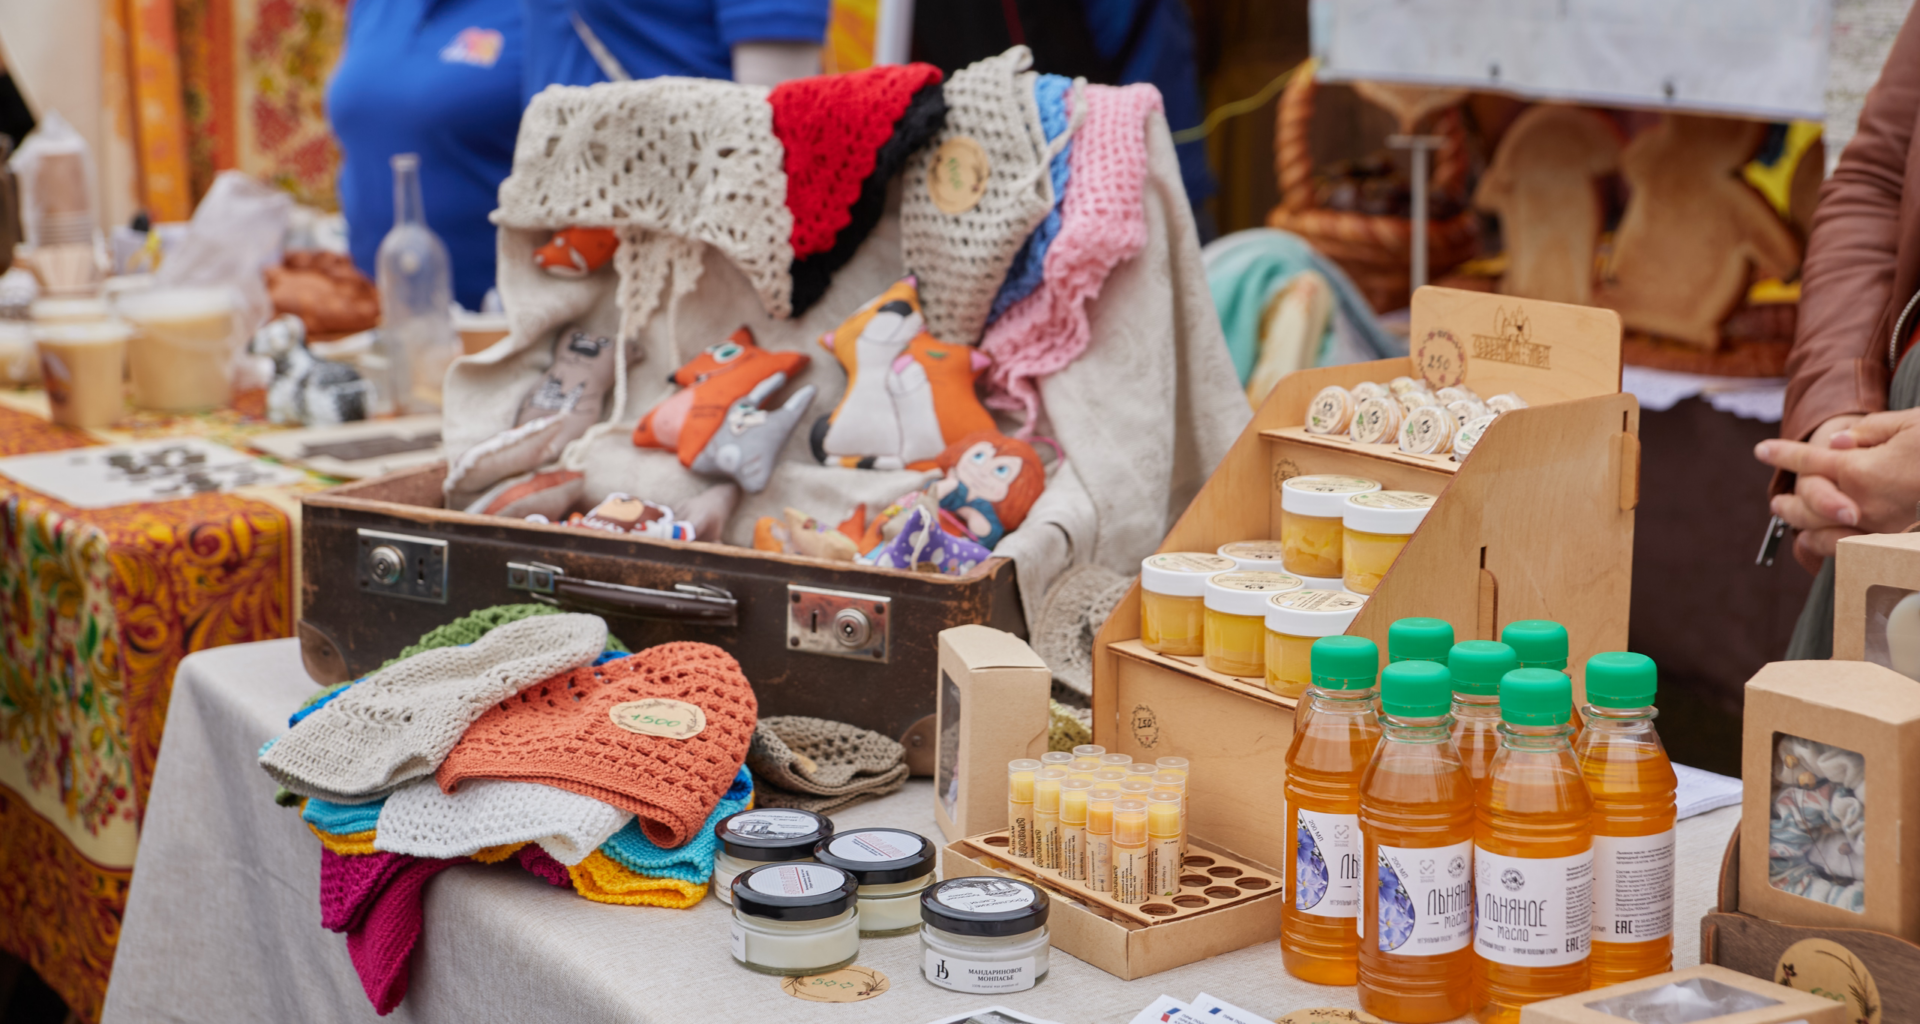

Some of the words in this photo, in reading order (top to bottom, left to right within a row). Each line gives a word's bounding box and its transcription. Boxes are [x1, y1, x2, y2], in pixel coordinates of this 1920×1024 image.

[1427, 354, 1451, 371] 250
[631, 713, 681, 727] 1500
[1308, 818, 1317, 831] 200
[1391, 856, 1401, 870] 200
[1484, 892, 1548, 928] ЛЬНЯНОЕ
[1444, 909, 1468, 929] масло
[1497, 925, 1529, 942] масло
[1615, 920, 1633, 934] EAC
[1565, 935, 1580, 953] EAC
[968, 966, 1023, 976] МАНДАРИНОВОЕ
[811, 977, 854, 989] 500
